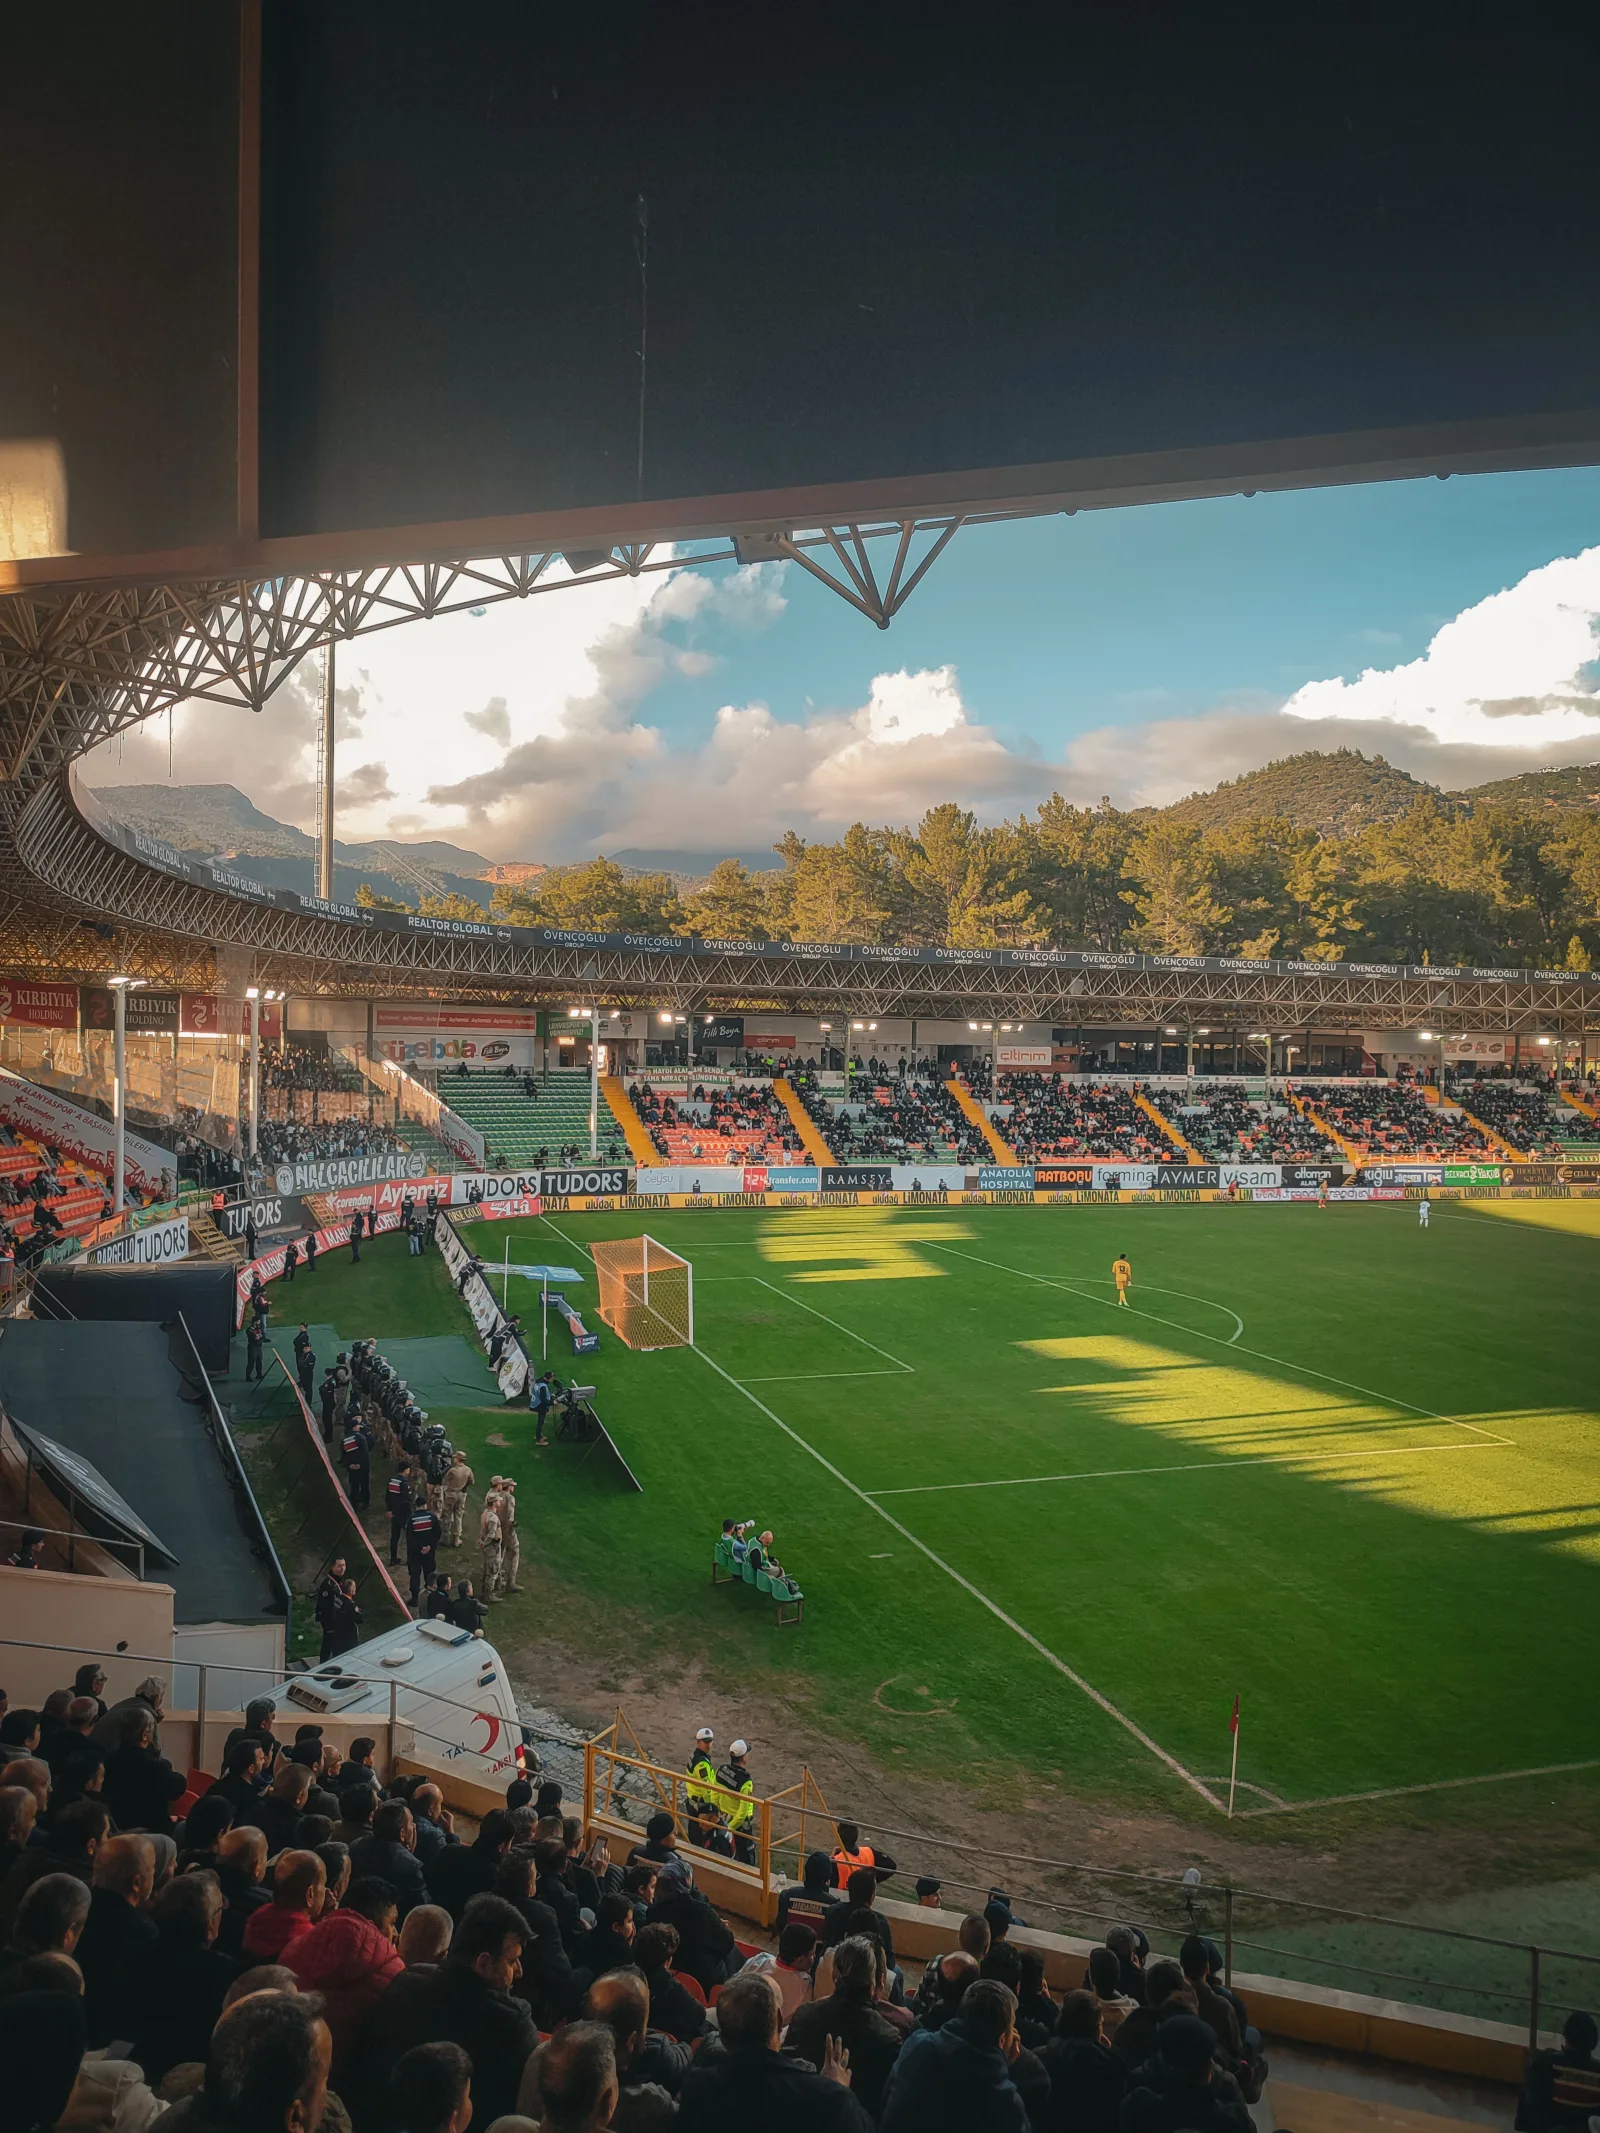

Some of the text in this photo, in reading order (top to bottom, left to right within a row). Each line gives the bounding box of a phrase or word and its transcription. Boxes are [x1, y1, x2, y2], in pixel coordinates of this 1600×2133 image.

[135, 831, 181, 868] REALTOR GLOBAL
[212, 868, 266, 896] REALTOR GLOBAL
[300, 896, 359, 918] REALTOR GLOBAL
[408, 916, 493, 936] REALTOR GLOBAL
[544, 930, 606, 943] ÖVENÇOĞLU
[704, 940, 765, 951] ÖVENÇOĞLU
[782, 944, 841, 954] ÖVENÇOĞLU
[862, 946, 920, 957] ÖVENÇOĞLU
[936, 949, 992, 959] ÖVENÇOĞLU
[1012, 952, 1066, 962] ÖVENÇOĞLU
[1082, 954, 1135, 964] ÖVENÇOĞLU
[1154, 957, 1206, 967] ÖVENÇOĞLU
[1220, 959, 1270, 969] ÖVENÇOĞLU
[1288, 962, 1337, 972] ÖVENÇOĞLU
[1350, 964, 1397, 973] ÖVENÇOĞLU
[1414, 966, 1460, 976] ÖVENÇOĞLU
[1473, 969, 1518, 978] ÖVENÇOĞLU
[1534, 970, 1579, 980] ÖVENÇOĞLU
[16, 989, 74, 1008] KIRBIYIK
[112, 996, 177, 1014] RBIYIK
[29, 1009, 63, 1021] HOLDİNG
[126, 1013, 164, 1025] HOLDİNG
[703, 1027, 718, 1038] Filli
[720, 1026, 740, 1037] Boya
[23, 1102, 55, 1122] corendon
[82, 1116, 115, 1136] BAŞARIL
[828, 1174, 886, 1185] RAMSEY
[981, 1169, 1032, 1178] ANATOLIA
[1035, 1170, 1092, 1183] IRATBORU
[1098, 1168, 1152, 1182] formina
[1160, 1171, 1216, 1184] AYMER
[1224, 1170, 1276, 1184] visam
[463, 1176, 536, 1198] TUDORS
[545, 1172, 623, 1194] TUDORS
[981, 1181, 1032, 1189] HOSPITAL
[379, 1180, 448, 1208] Aytemiz
[336, 1194, 372, 1208] corendon
[585, 1198, 614, 1210] uludağ
[685, 1195, 713, 1207] uludağ
[448, 1206, 482, 1223] ORSE GOLD
[138, 1224, 186, 1262] TUDORS
